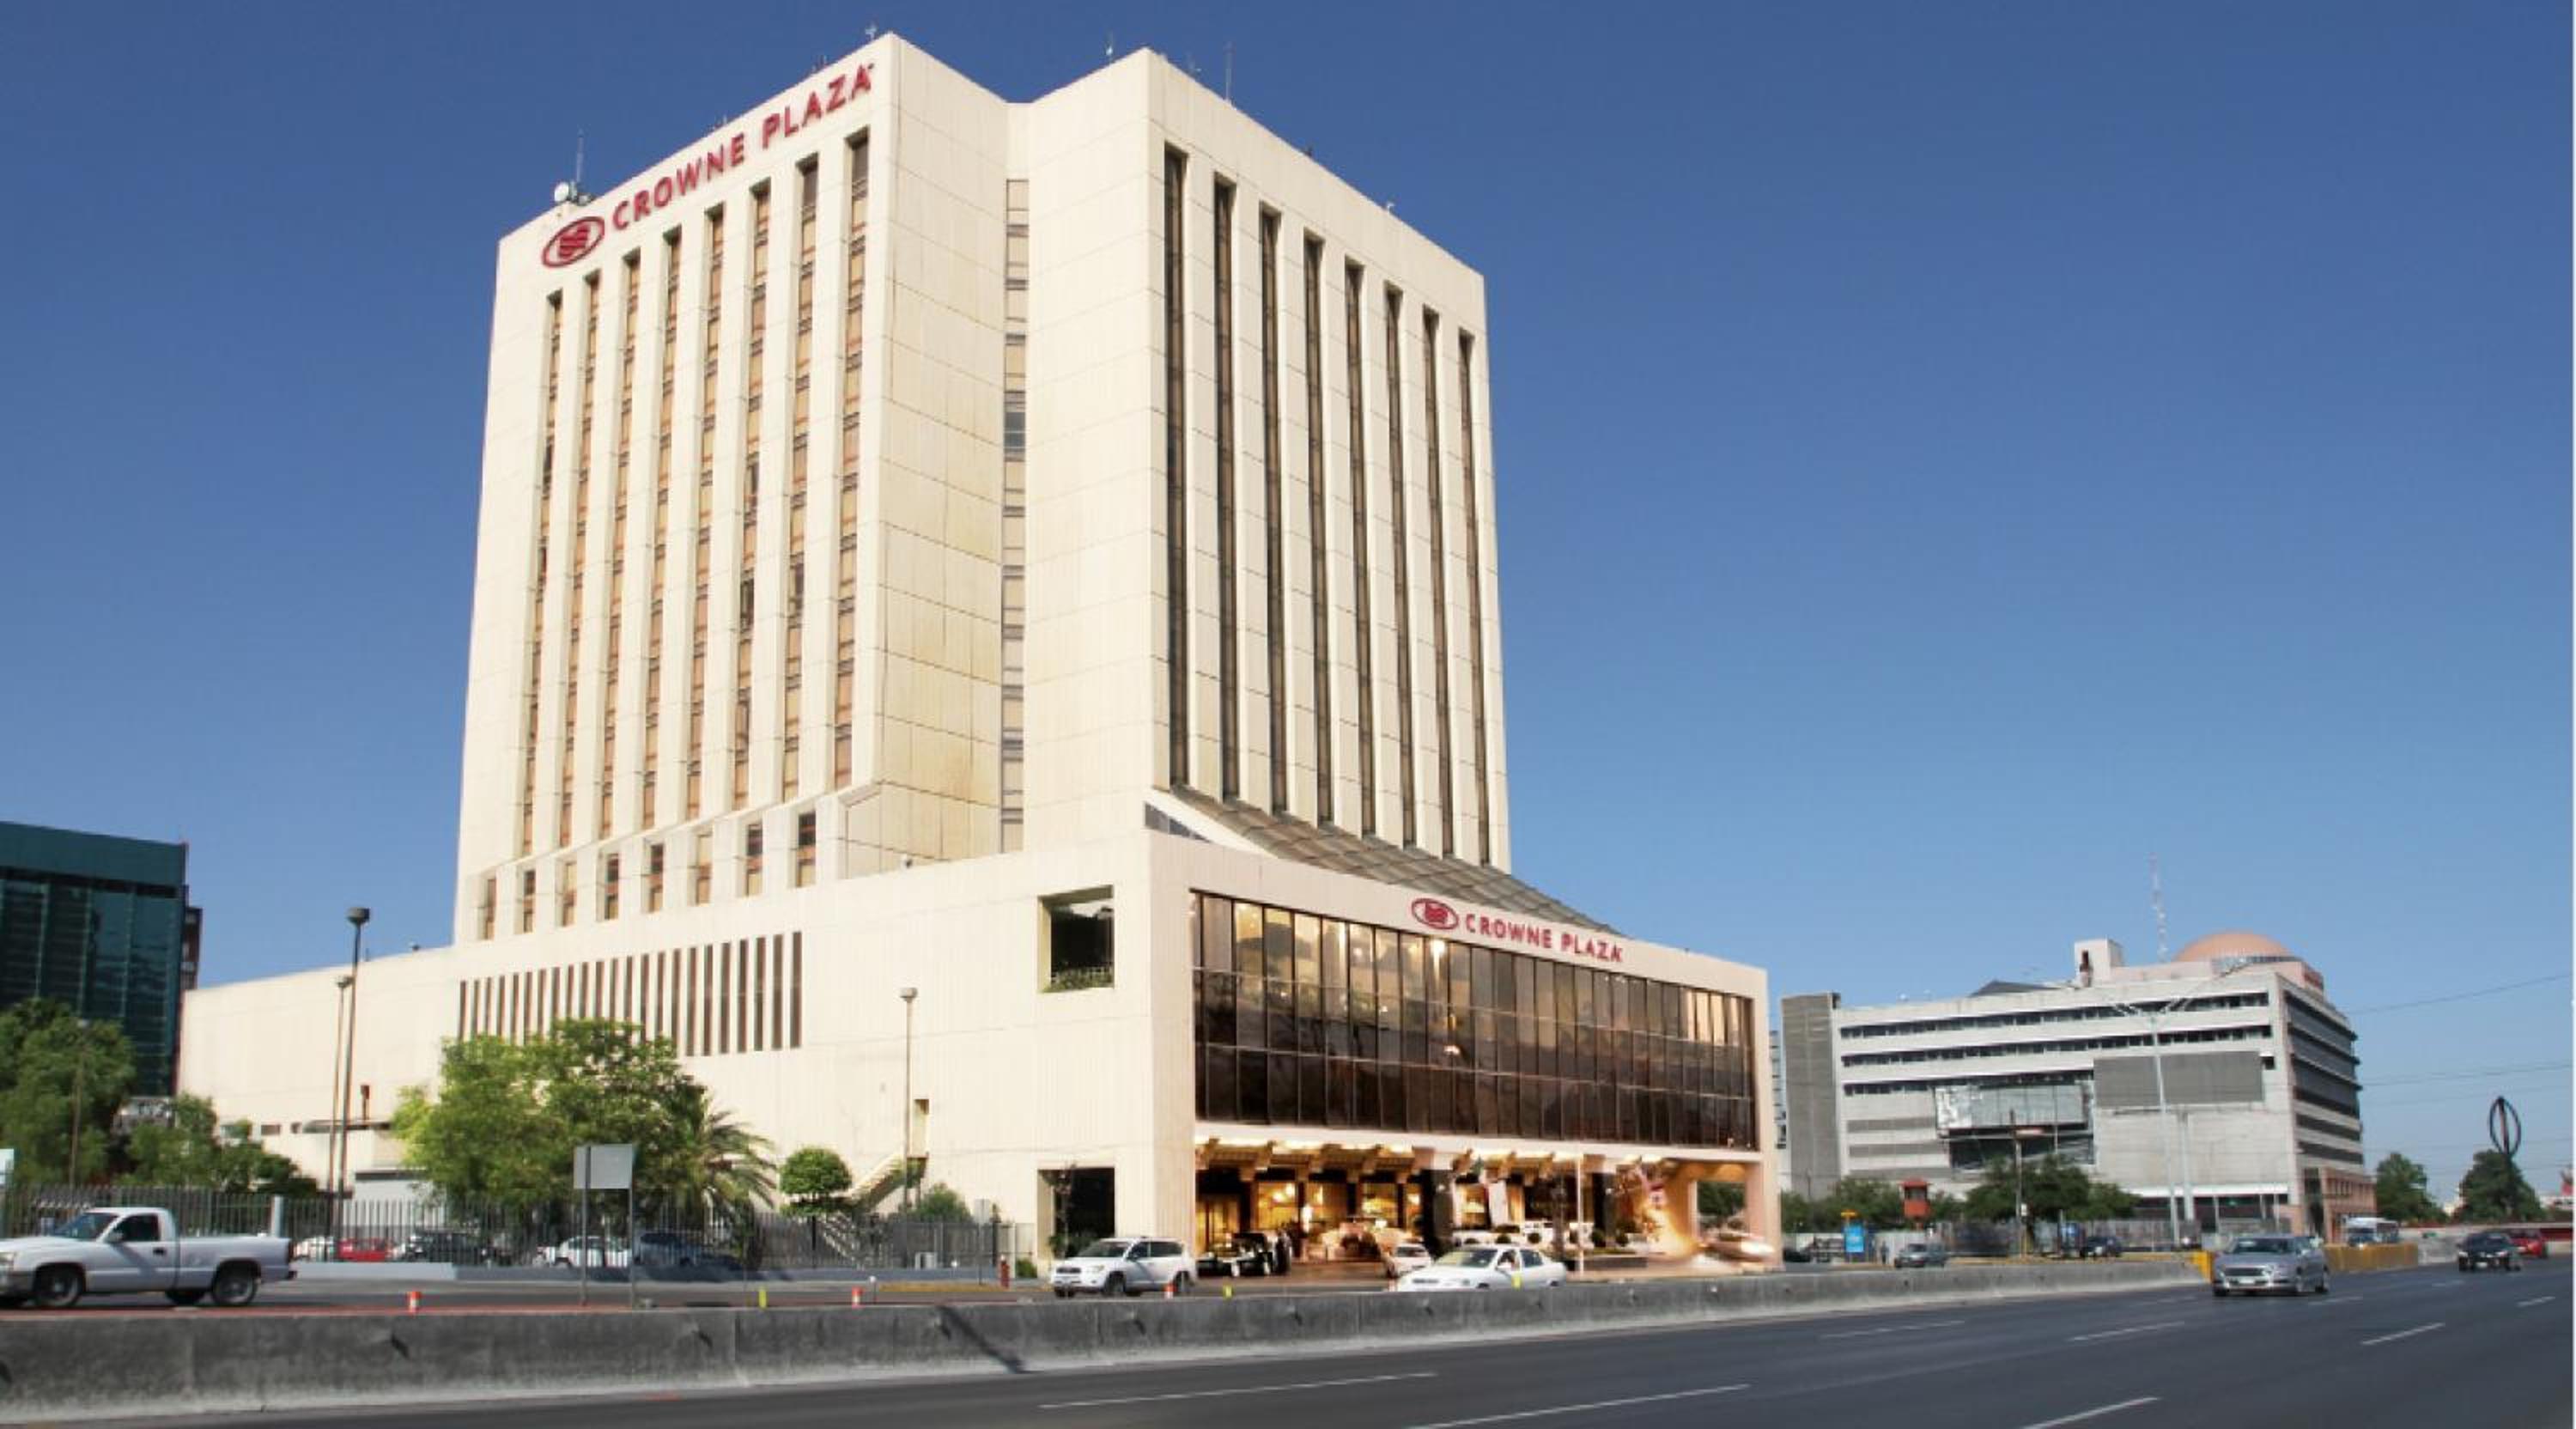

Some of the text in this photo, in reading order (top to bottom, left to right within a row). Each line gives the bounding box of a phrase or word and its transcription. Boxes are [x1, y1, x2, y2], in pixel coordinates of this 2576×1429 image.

[612, 64, 872, 230] CROWNE PLAZA
[1466, 913, 1622, 963] CROWNE PLAZA
